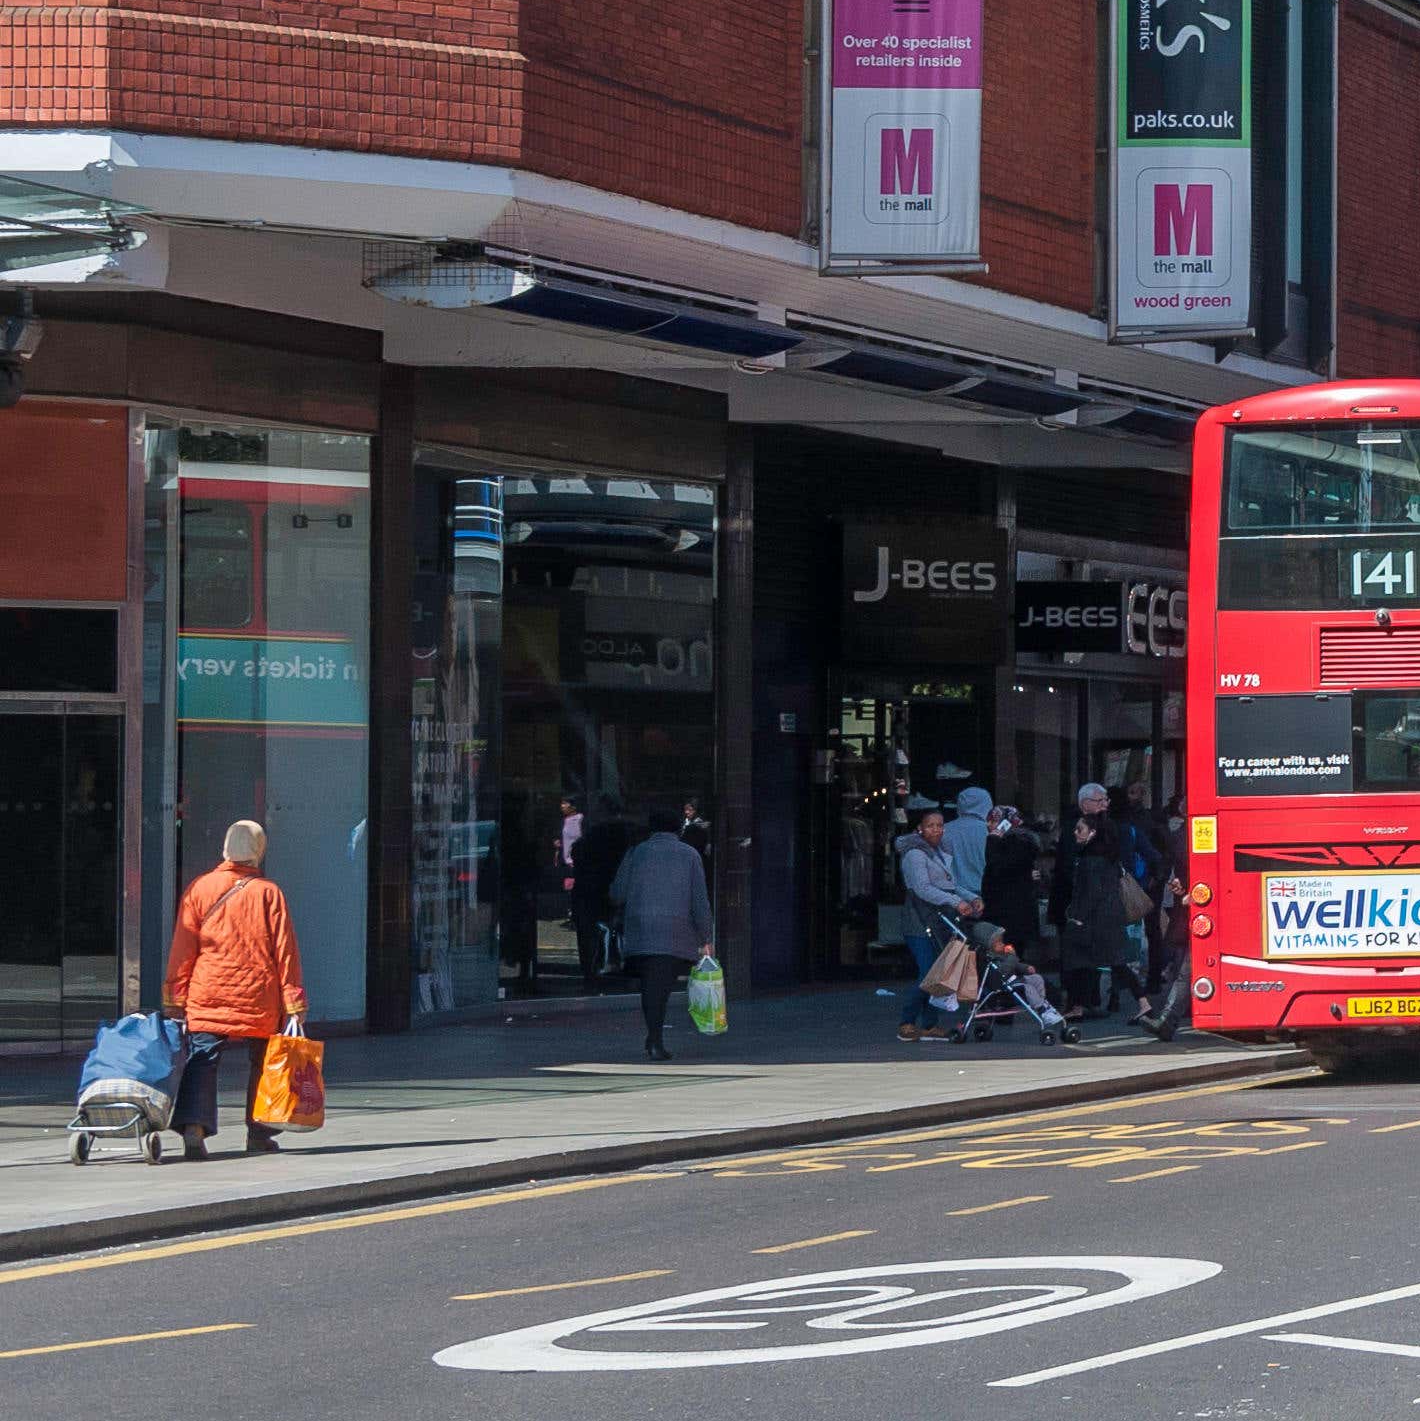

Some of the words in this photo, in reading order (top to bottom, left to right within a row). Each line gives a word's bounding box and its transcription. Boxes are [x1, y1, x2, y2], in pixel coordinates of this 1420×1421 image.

[843, 35, 877, 48] Over
[881, 36, 899, 48] 40
[902, 35, 972, 51] specialist
[855, 54, 914, 66] retailers
[918, 54, 962, 67] inside
[1133, 109, 1235, 133] paks.co.uk
[880, 128, 933, 195] M
[879, 198, 900, 212] the
[904, 198, 933, 212] mall
[1153, 184, 1213, 256] M
[1153, 258, 1177, 275] the
[1180, 258, 1213, 275] mall
[1133, 291, 1182, 309] wood
[1184, 293, 1231, 312] green
[853, 546, 997, 602] J-BEES
[1352, 550, 1416, 596] 141
[1018, 606, 1118, 628] J-BEES
[1220, 675, 1243, 688] HV
[1244, 674, 1261, 687] 78
[1218, 757, 1236, 767] For
[1237, 759, 1245, 767] a
[1247, 757, 1281, 767] career
[1282, 755, 1306, 766] with
[1307, 756, 1324, 766] us,
[1326, 754, 1350, 765] visit
[1224, 766, 1341, 777] www.arrivalondon.com
[1299, 880, 1322, 888] Made
[1322, 880, 1333, 888] in
[1299, 889, 1333, 897] Britain
[1273, 933, 1359, 949] VITAMINS
[1365, 932, 1401, 946] FOR
[1354, 1000, 1393, 1014] LJ62
[587, 1285, 1088, 1332] 20
